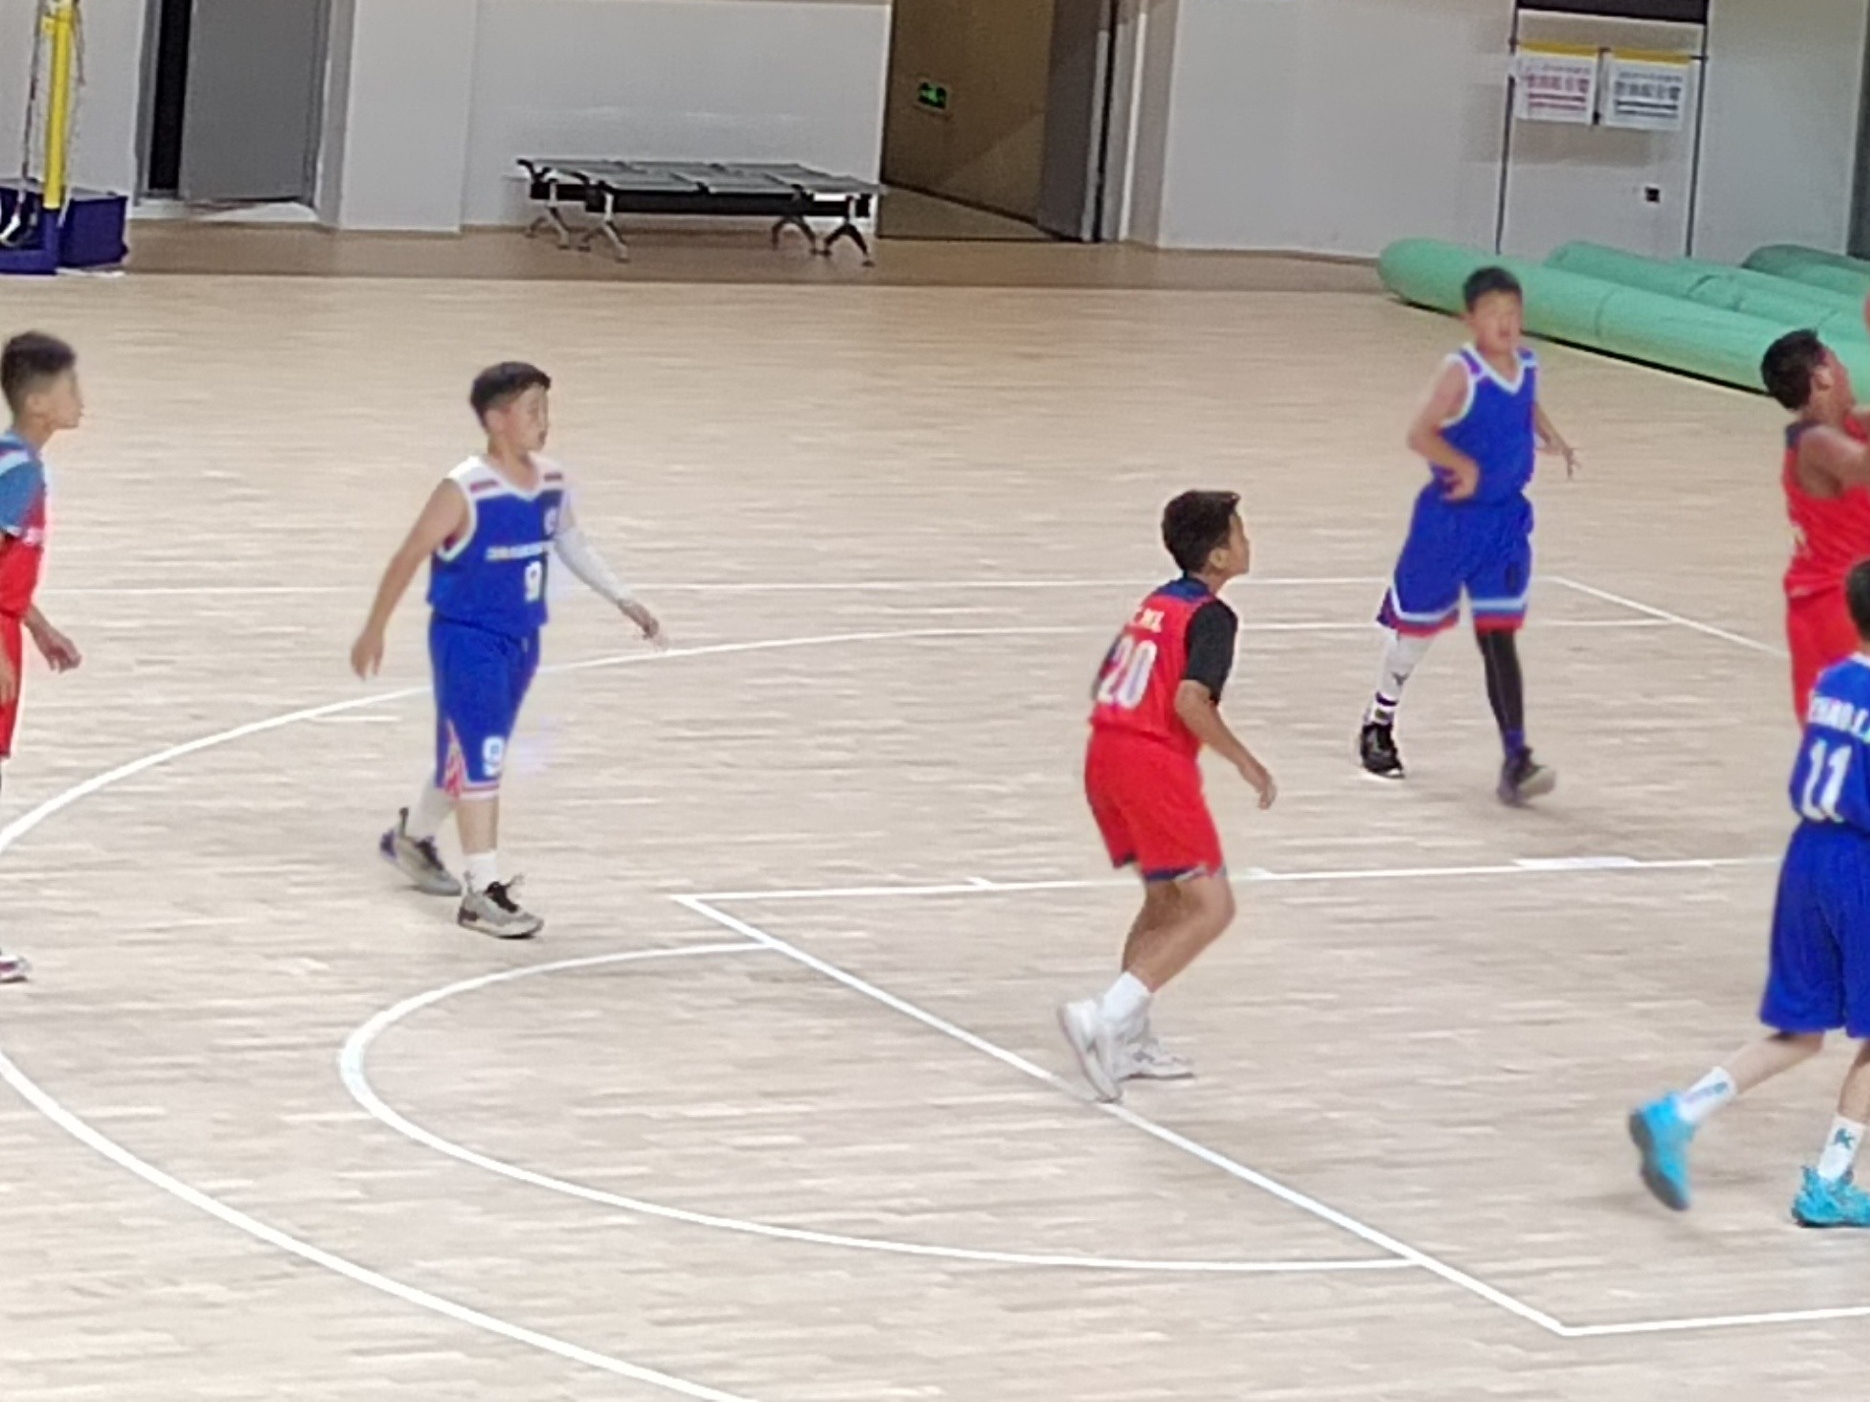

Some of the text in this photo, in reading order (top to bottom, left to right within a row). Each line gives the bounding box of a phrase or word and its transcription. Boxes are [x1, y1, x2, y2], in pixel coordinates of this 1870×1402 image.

[525, 560, 542, 602] 9
[1097, 634, 1158, 710] 20
[482, 735, 505, 778] 9
[1802, 738, 1853, 824] 11
